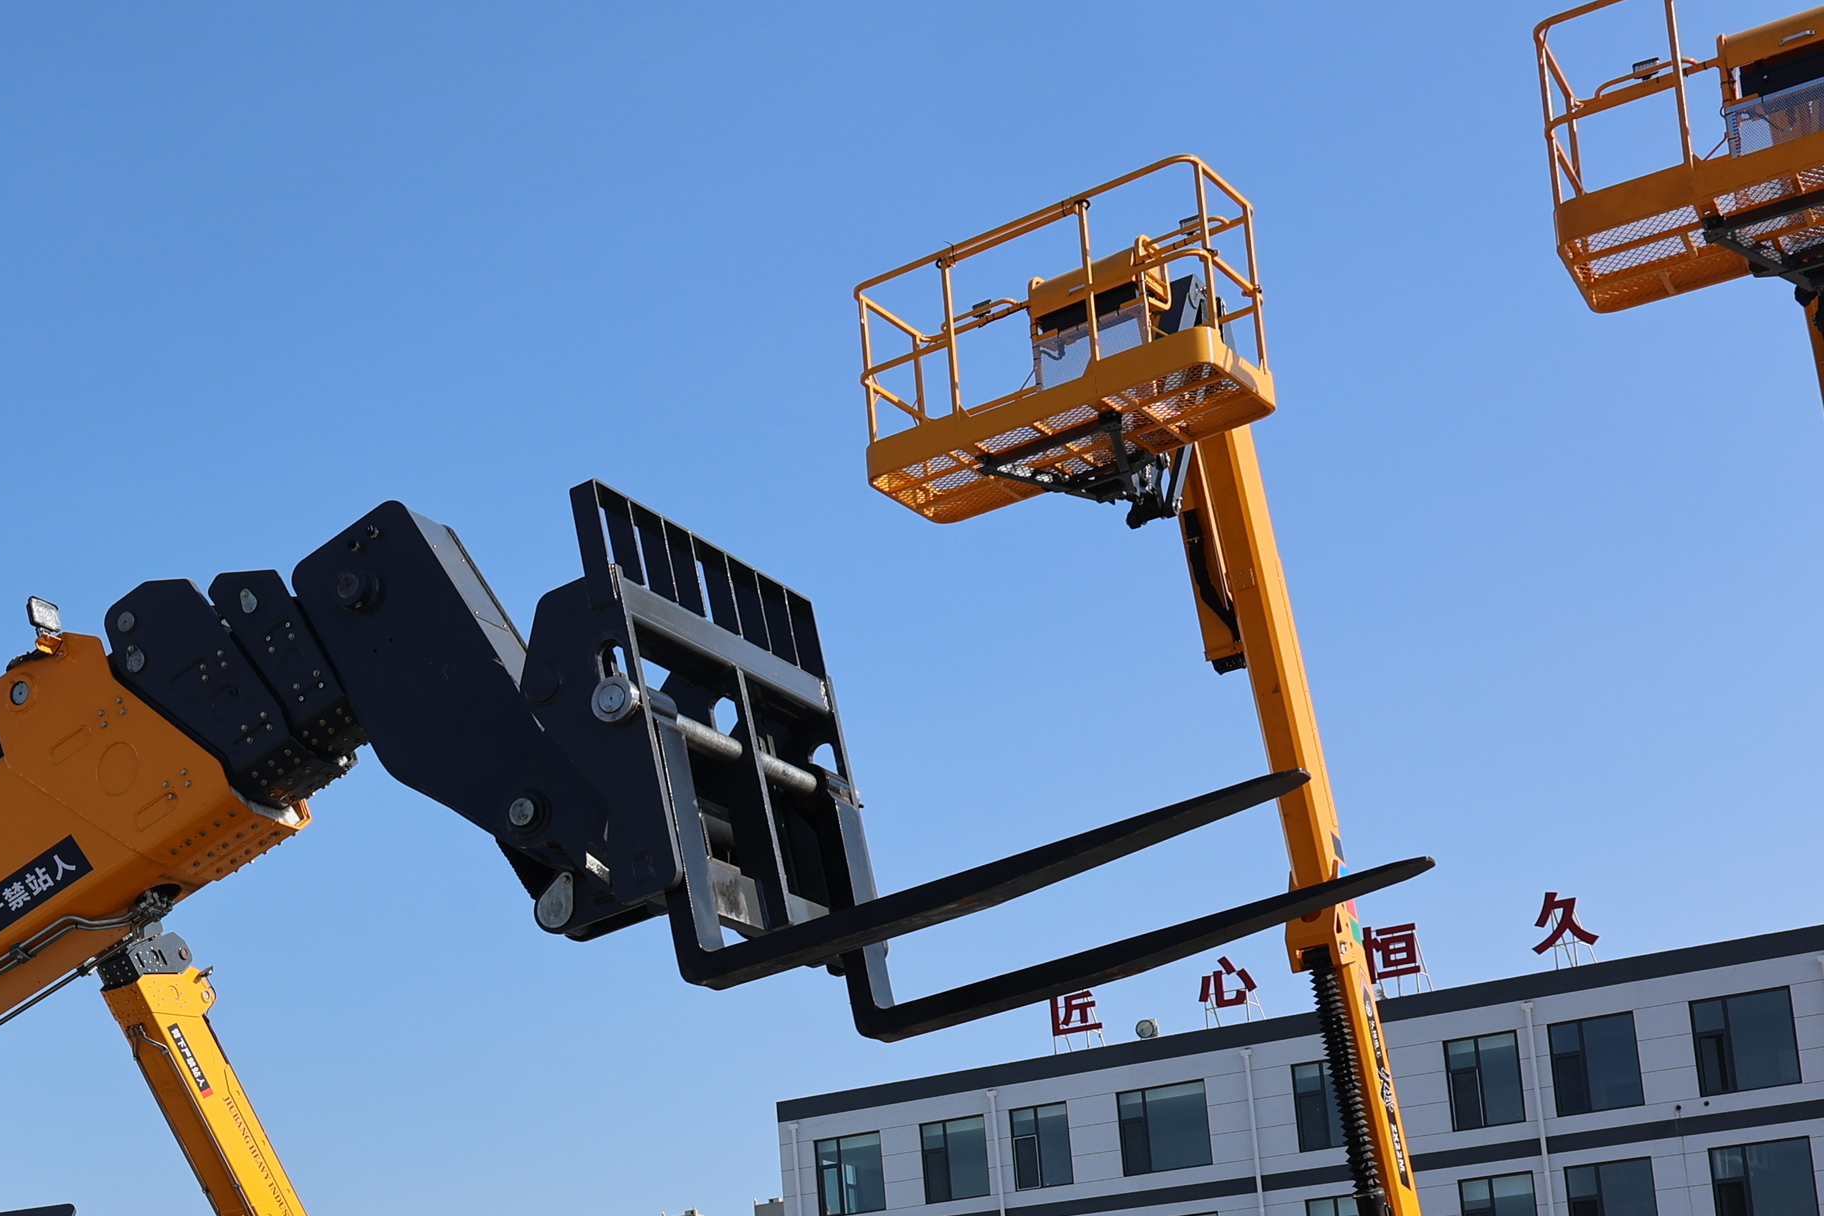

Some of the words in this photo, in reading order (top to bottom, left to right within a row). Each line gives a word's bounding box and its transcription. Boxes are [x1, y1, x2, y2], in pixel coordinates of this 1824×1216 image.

[1050, 892, 1599, 1037] 匠心恒久
[222, 1096, 250, 1144] JIUBANG
[249, 1145, 271, 1181] HEAVY
[1390, 1122, 1406, 1174] ZX22M
